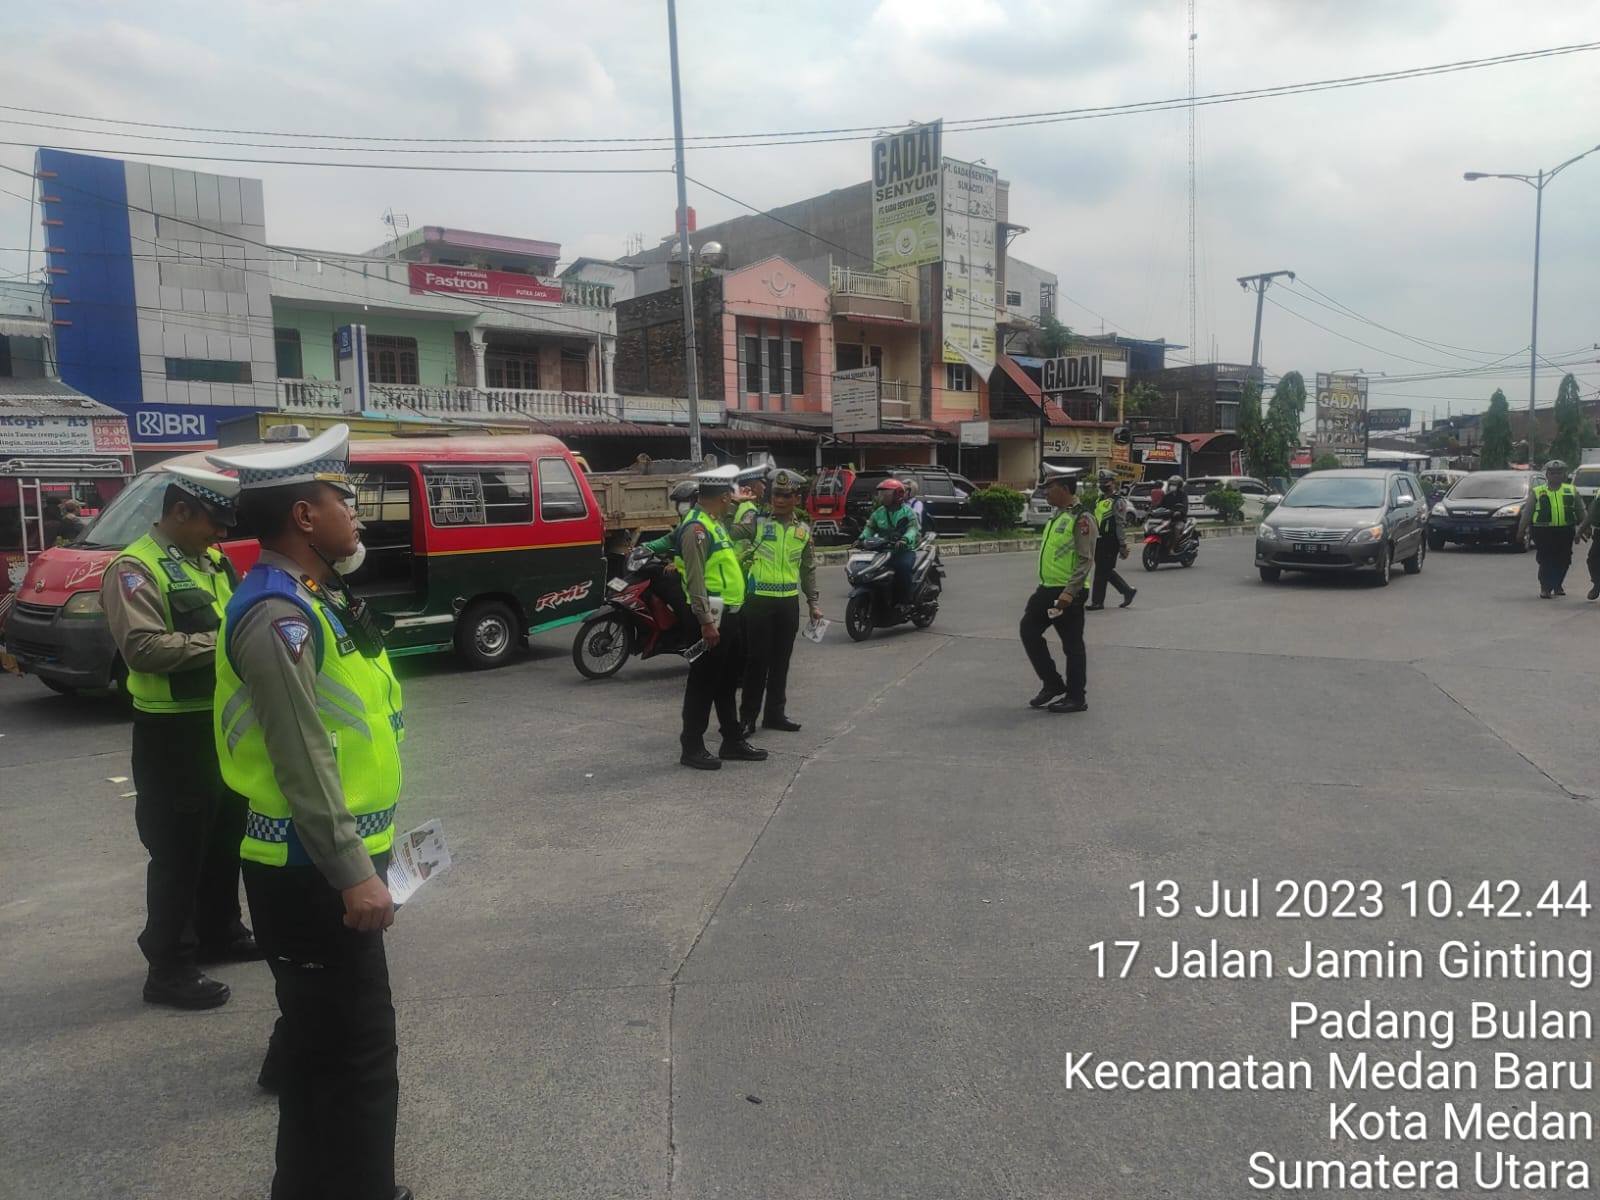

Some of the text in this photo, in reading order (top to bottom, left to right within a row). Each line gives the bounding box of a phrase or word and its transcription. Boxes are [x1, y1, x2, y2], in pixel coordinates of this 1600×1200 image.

[875, 122, 939, 188] GADAI
[876, 173, 938, 203] SENYUM
[425, 273, 489, 290] Fastron
[1044, 355, 1097, 389] GADAI
[1319, 391, 1366, 410] GADAI
[165, 414, 206, 435] BRI
[1054, 440, 1070, 453] 5%
